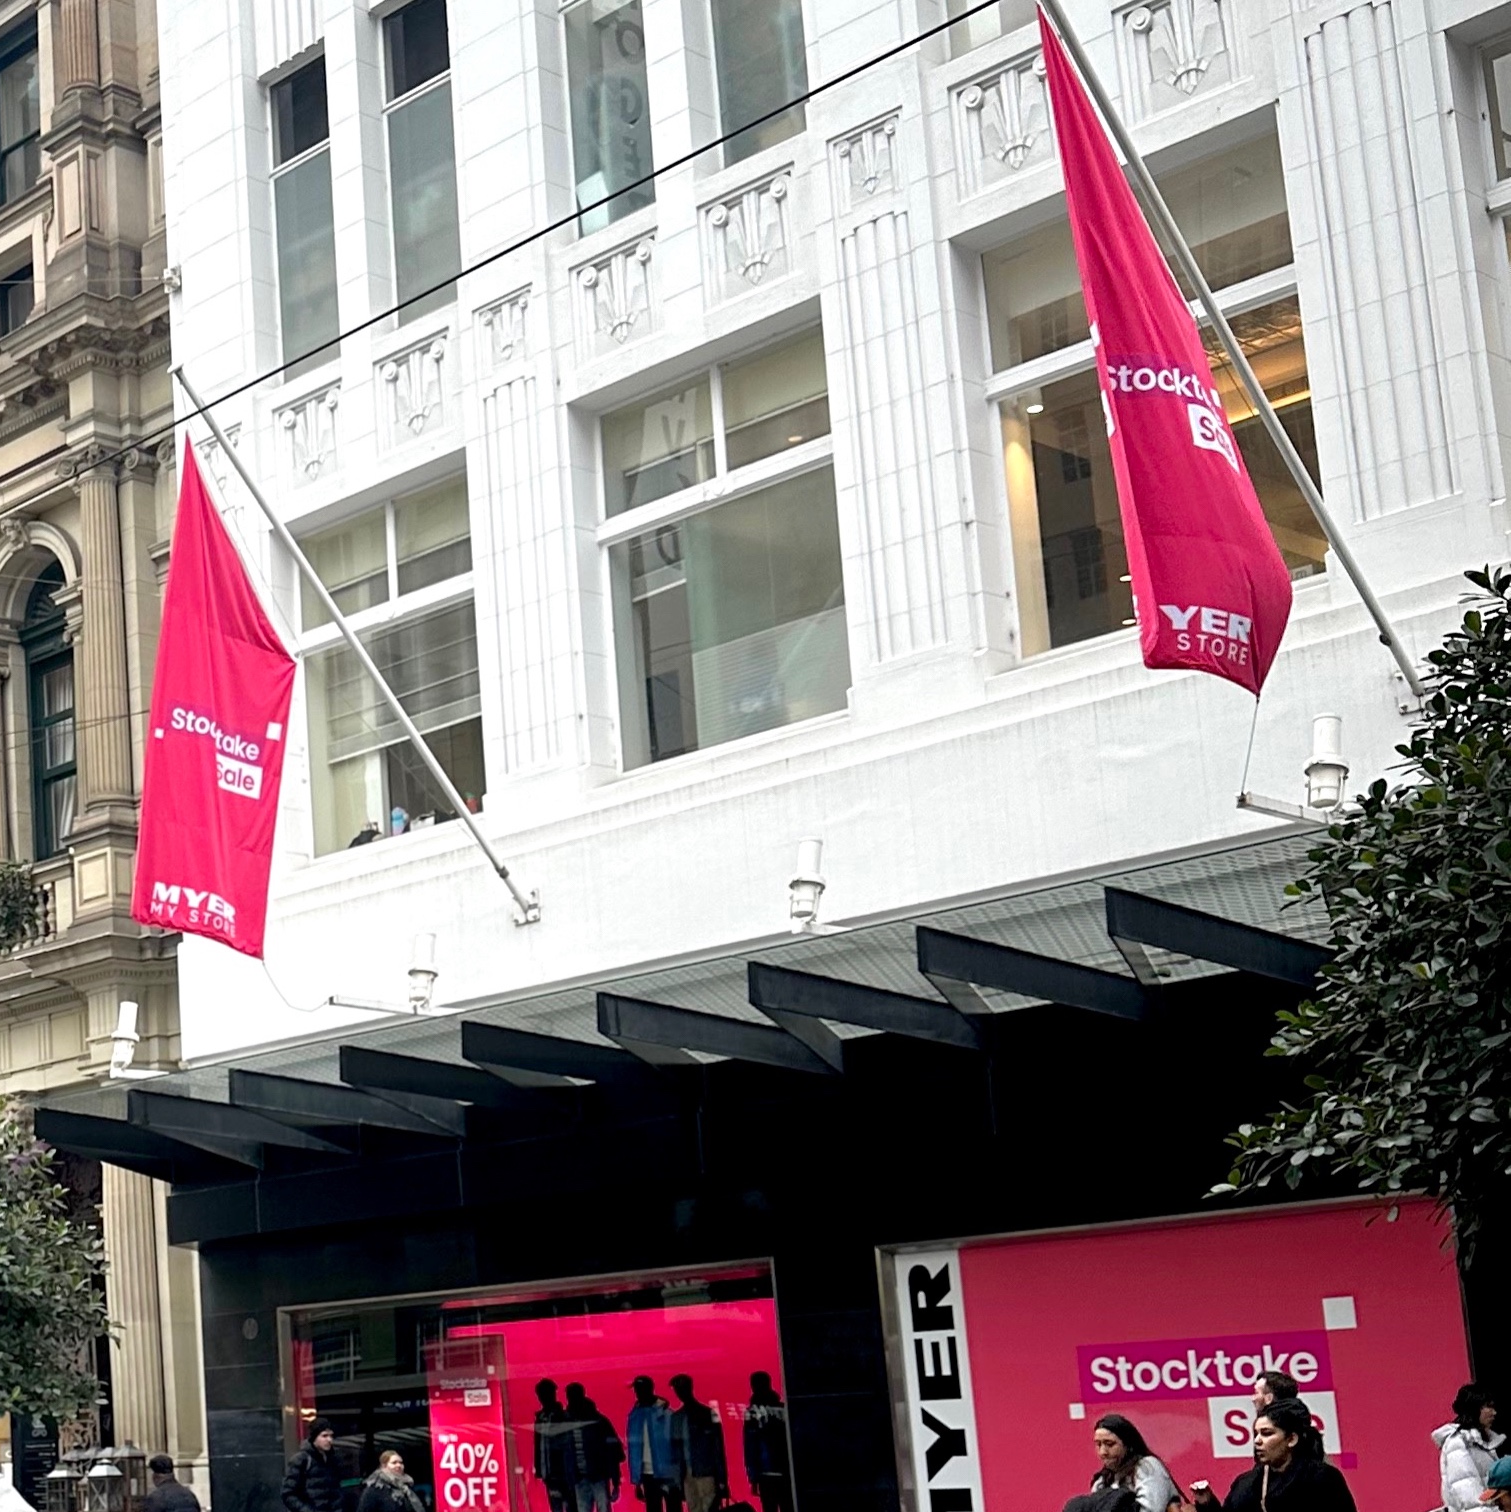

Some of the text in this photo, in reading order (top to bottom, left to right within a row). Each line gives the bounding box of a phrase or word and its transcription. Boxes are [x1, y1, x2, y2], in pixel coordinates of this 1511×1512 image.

[1106, 365, 1213, 408] Stockt
[1177, 633, 1248, 666] STORE
[150, 901, 178, 918] MY
[152, 881, 236, 924] MYER
[1090, 1345, 1318, 1393] Stocktake
[440, 1442, 499, 1474] 40%
[444, 1477, 498, 1508] OFF
